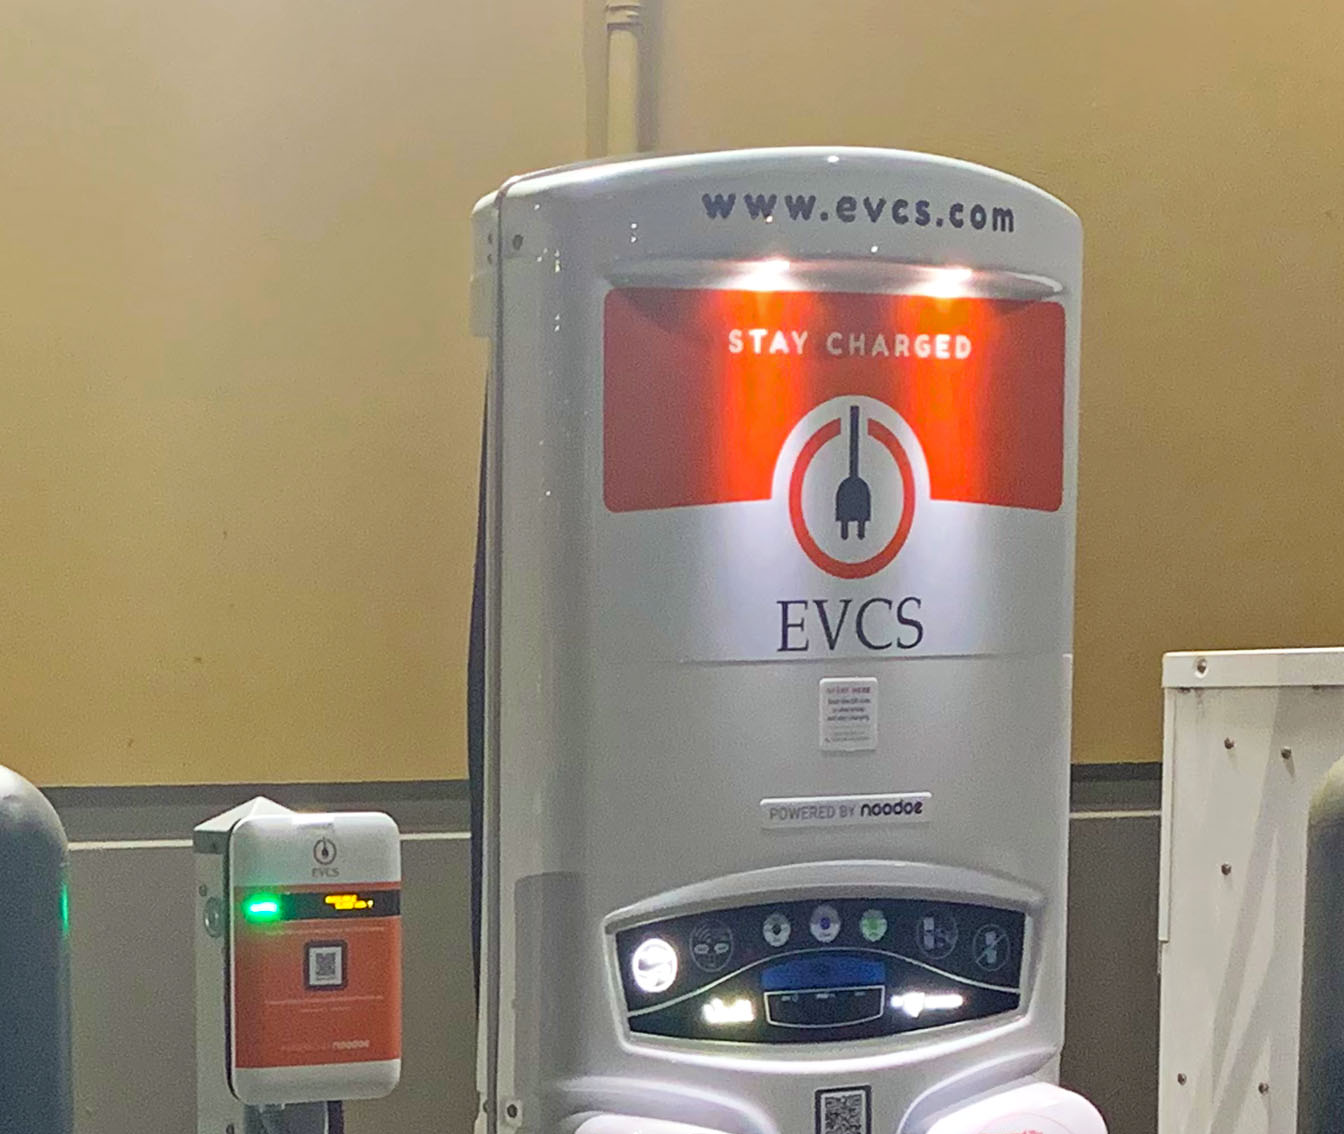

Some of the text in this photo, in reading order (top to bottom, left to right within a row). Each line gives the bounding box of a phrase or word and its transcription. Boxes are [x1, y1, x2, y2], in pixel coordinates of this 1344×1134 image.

[701, 191, 1016, 234] www.evcs.com
[728, 327, 972, 360] STAY CHARGED
[776, 596, 925, 653] EVCS
[769, 805, 836, 821] POWERED
[838, 804, 855, 818] BY
